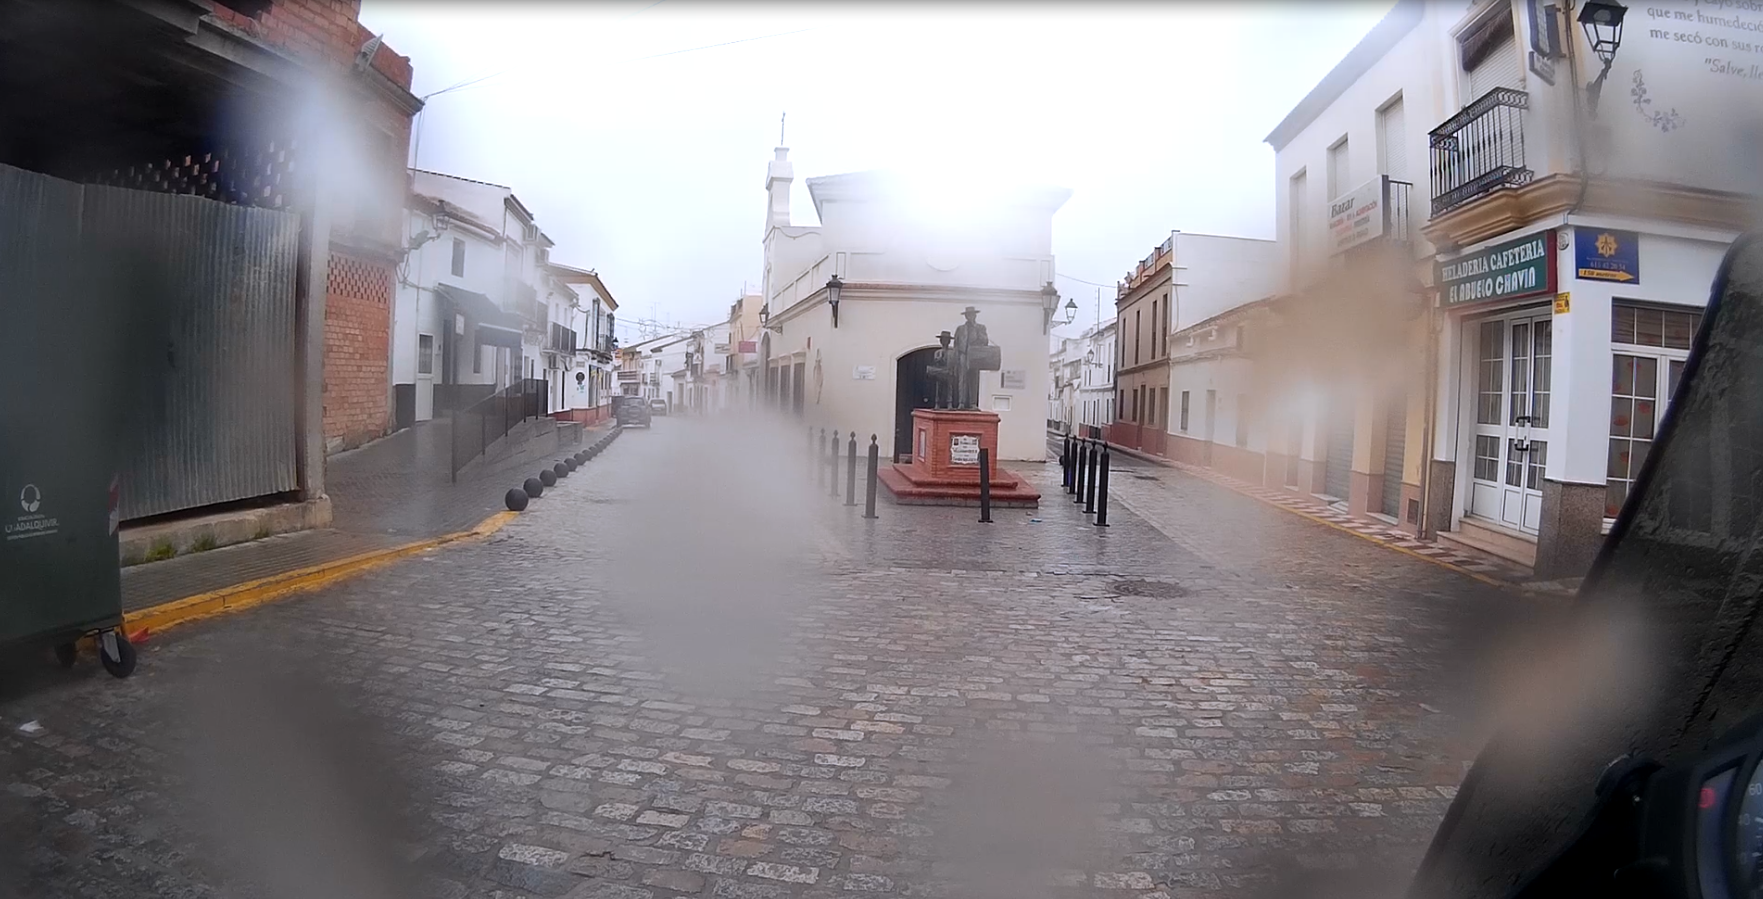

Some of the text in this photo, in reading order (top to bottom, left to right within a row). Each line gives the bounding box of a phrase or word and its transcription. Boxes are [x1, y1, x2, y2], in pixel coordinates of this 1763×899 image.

[1647, 7, 1671, 20] que
[1674, 10, 1693, 22] me
[1650, 29, 1670, 40] me
[1673, 31, 1702, 44] secó
[1705, 36, 1728, 48] con
[1732, 40, 1752, 52] sus
[1705, 58, 1747, 79] "Salve,
[1331, 197, 1355, 218] Bazar
[1442, 239, 1545, 282] HELADERIA CAFETERIA
[1449, 267, 1536, 303] EL ABUELO CHAVIN
[1748, 783, 1762, 796] 60
